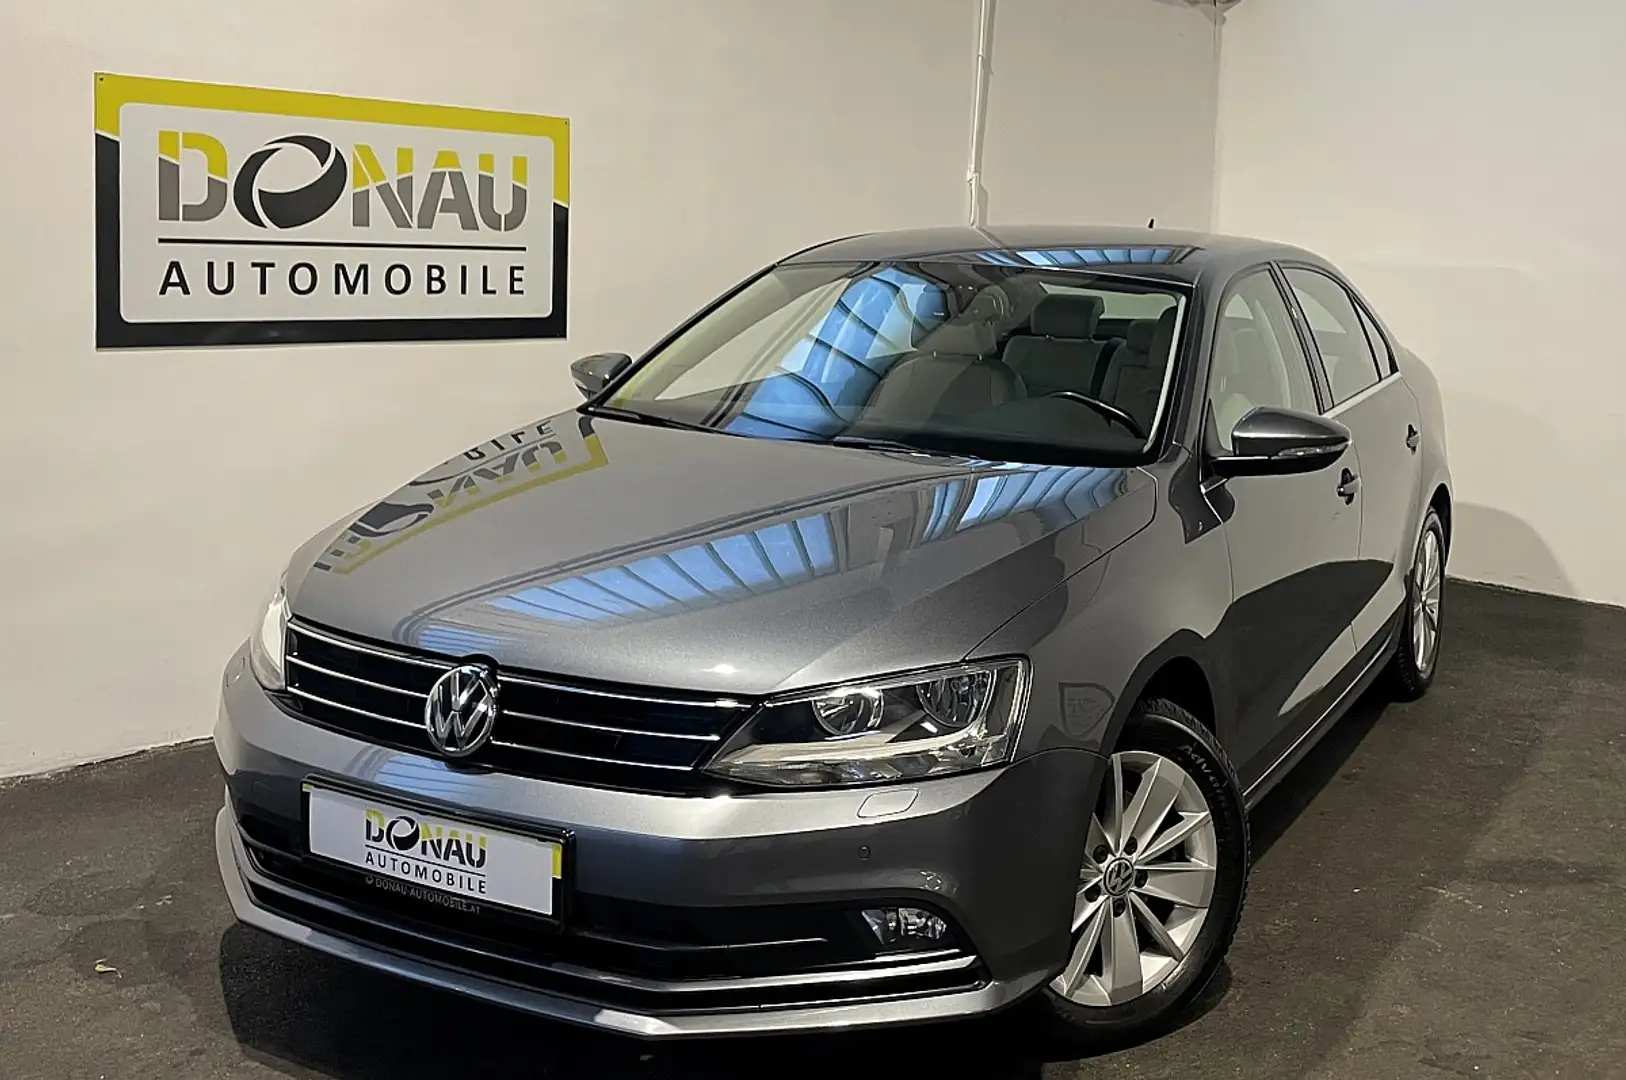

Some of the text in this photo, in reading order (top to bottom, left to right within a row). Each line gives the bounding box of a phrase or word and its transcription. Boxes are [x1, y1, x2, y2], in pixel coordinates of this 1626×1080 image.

[158, 131, 527, 232] DONAU
[158, 260, 526, 296] AUTOMOBILE
[366, 808, 487, 868] DONAU
[365, 851, 486, 894] AUTOMOBILE
